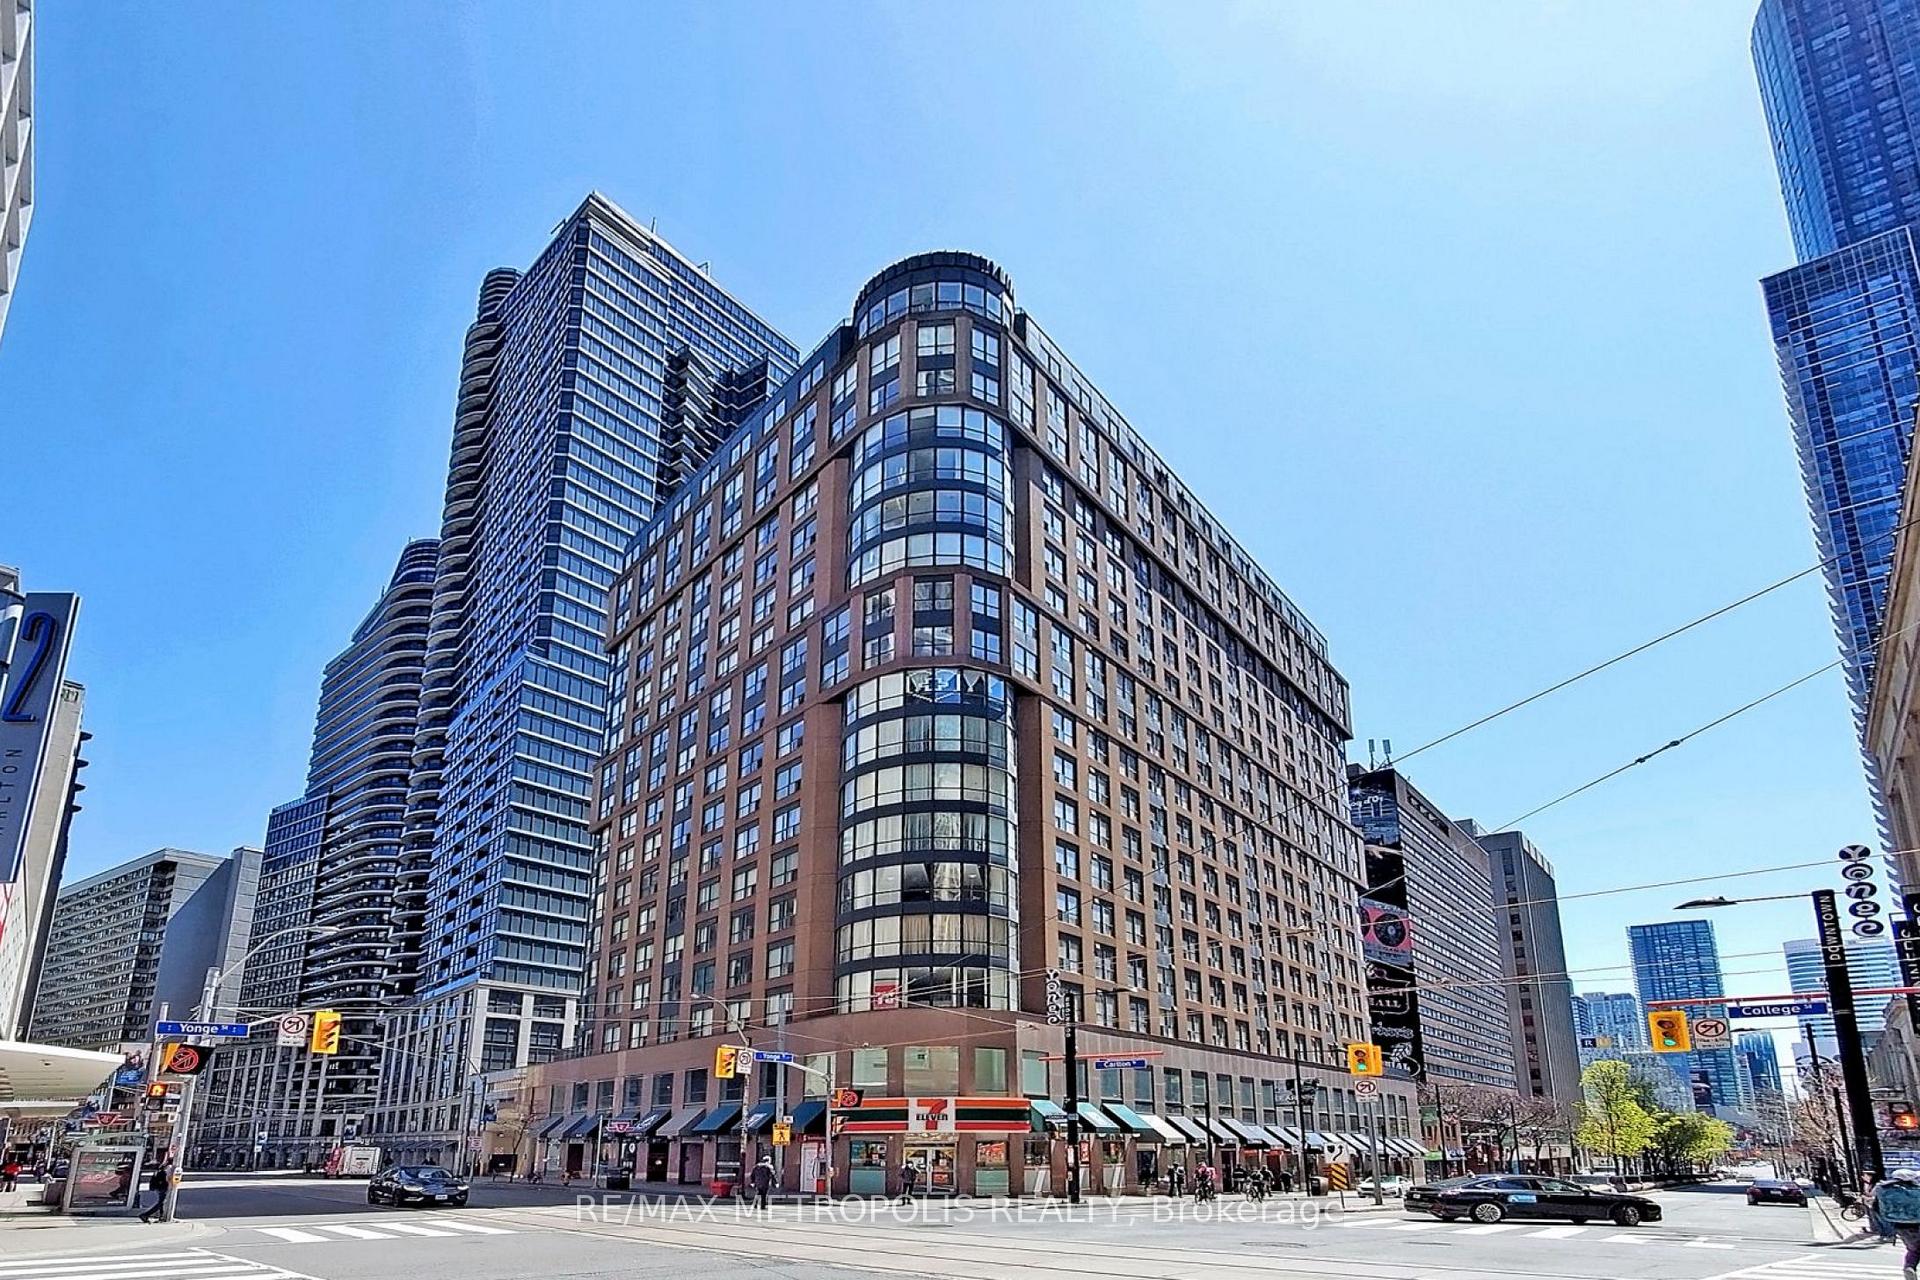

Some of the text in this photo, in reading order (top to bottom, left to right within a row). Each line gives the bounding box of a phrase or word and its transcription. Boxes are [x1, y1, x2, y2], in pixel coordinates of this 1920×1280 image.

[1839, 845, 1884, 937] Yonge
[1819, 895, 1841, 961] DOWNTOWN
[1742, 1005, 1800, 1016] College
[179, 1024, 218, 1034] Yonge
[917, 1099, 948, 1130] 7
